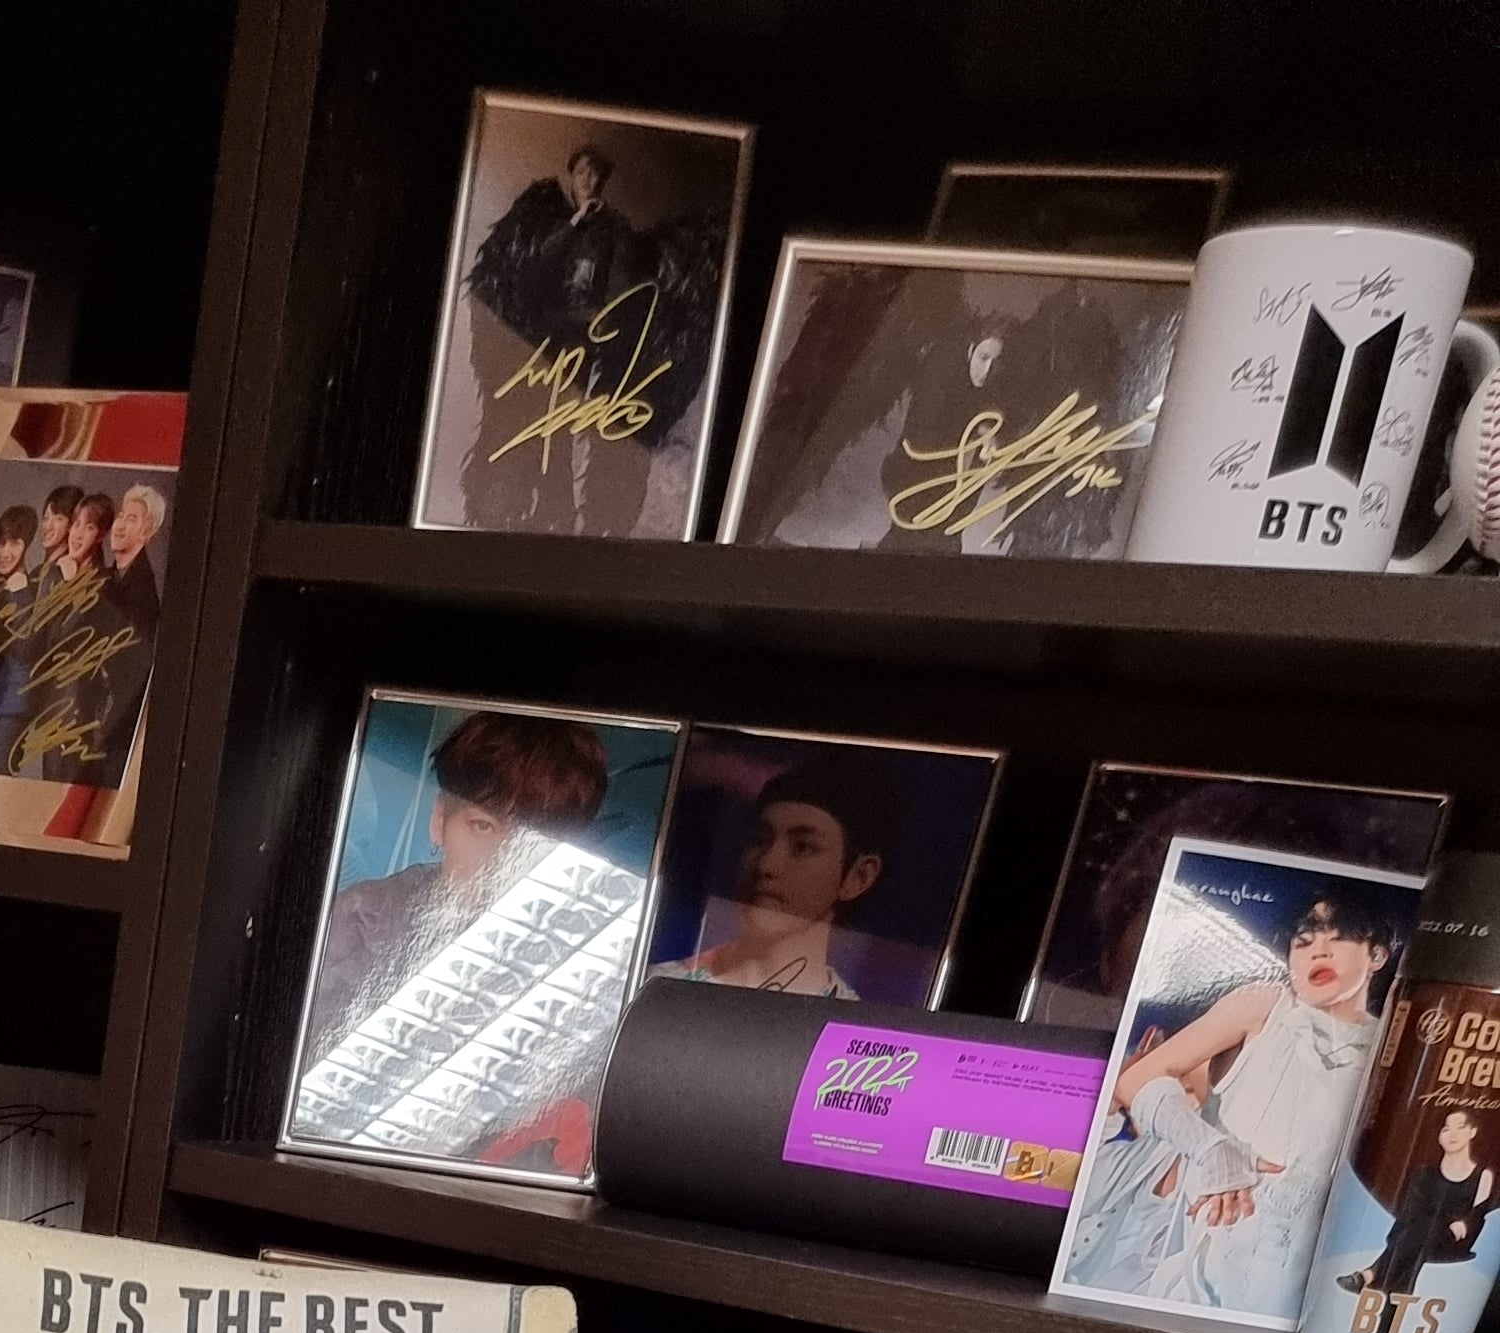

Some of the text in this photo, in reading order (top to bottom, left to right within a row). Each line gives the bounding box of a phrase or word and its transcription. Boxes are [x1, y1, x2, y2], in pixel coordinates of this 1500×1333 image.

[1258, 499, 1348, 546] BTS
[814, 1051, 919, 1111] 2022
[823, 1091, 892, 1117] GREETINGS
